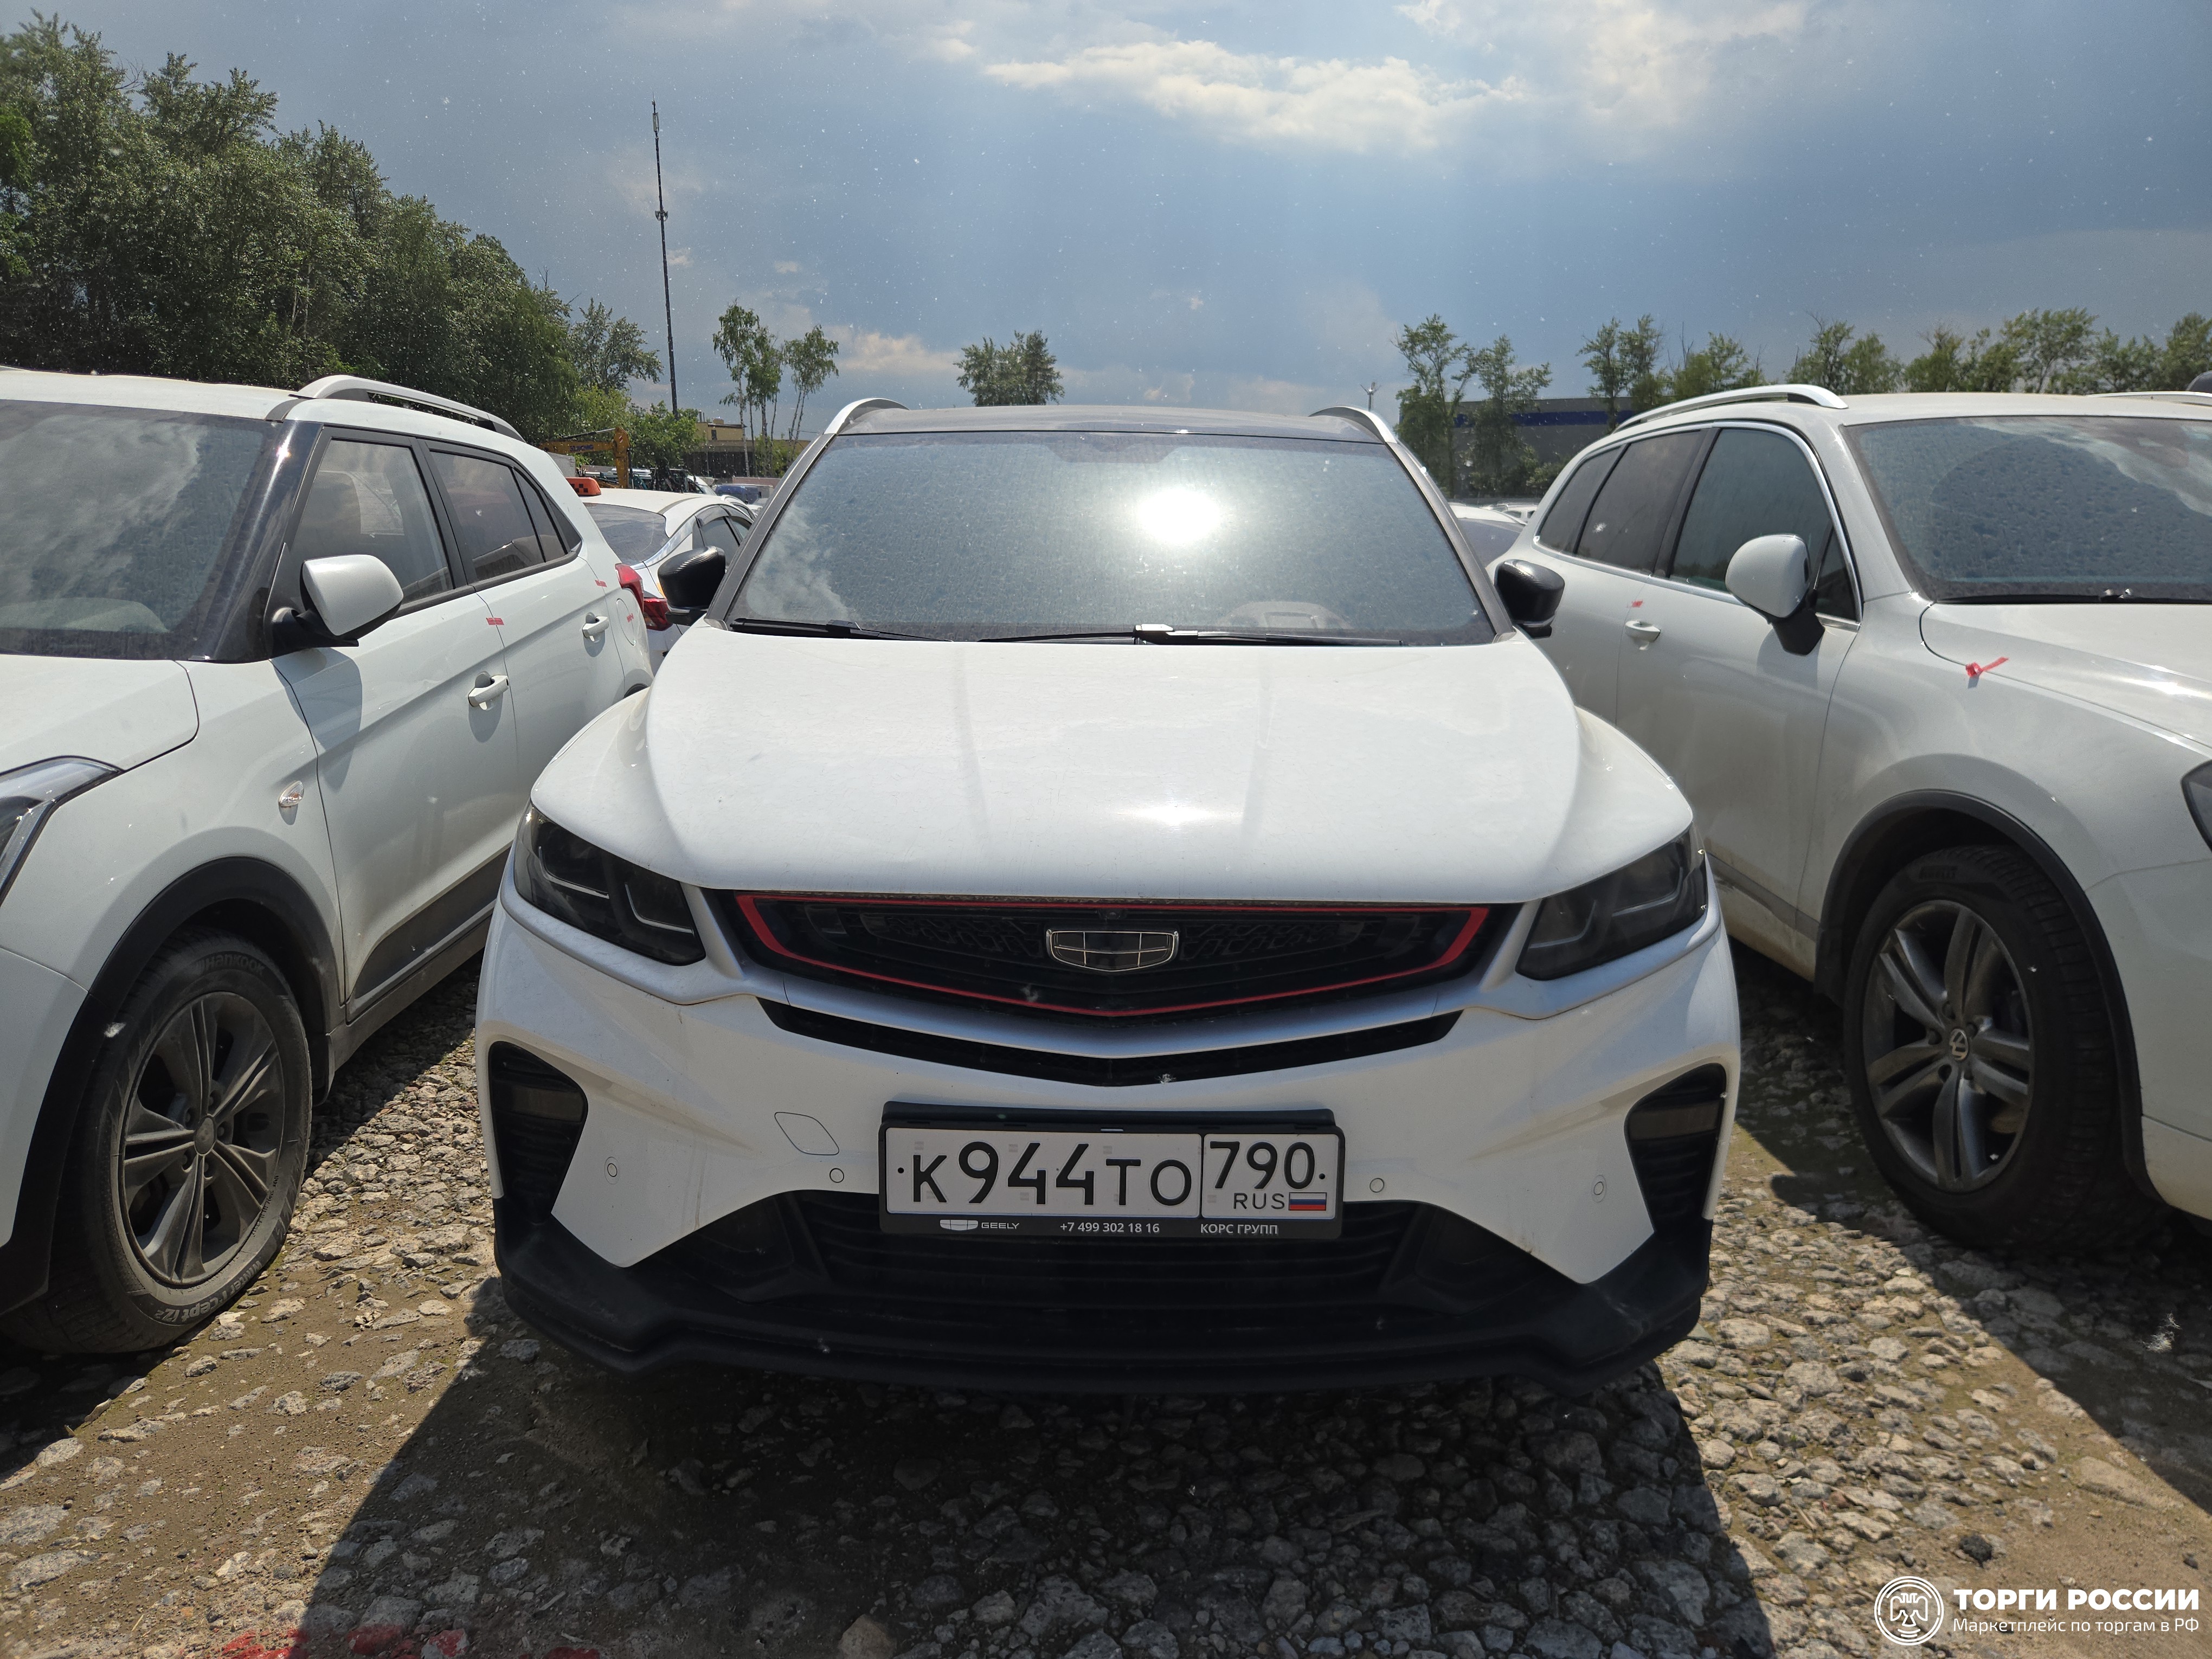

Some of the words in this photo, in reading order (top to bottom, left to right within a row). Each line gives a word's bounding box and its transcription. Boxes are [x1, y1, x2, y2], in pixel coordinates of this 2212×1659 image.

[1209, 1140, 1316, 1189] 790
[1233, 1193, 1285, 1210] RUS
[981, 1221, 1020, 1230] GEELY
[1060, 1221, 1075, 1232] +7
[1077, 1221, 1100, 1233] 499
[1102, 1222, 1125, 1233] 302
[1128, 1223, 1142, 1233] 18
[1145, 1223, 1160, 1233] 16
[1200, 1223, 1234, 1234] КОРС
[1237, 1224, 1279, 1235] ГРУПП
